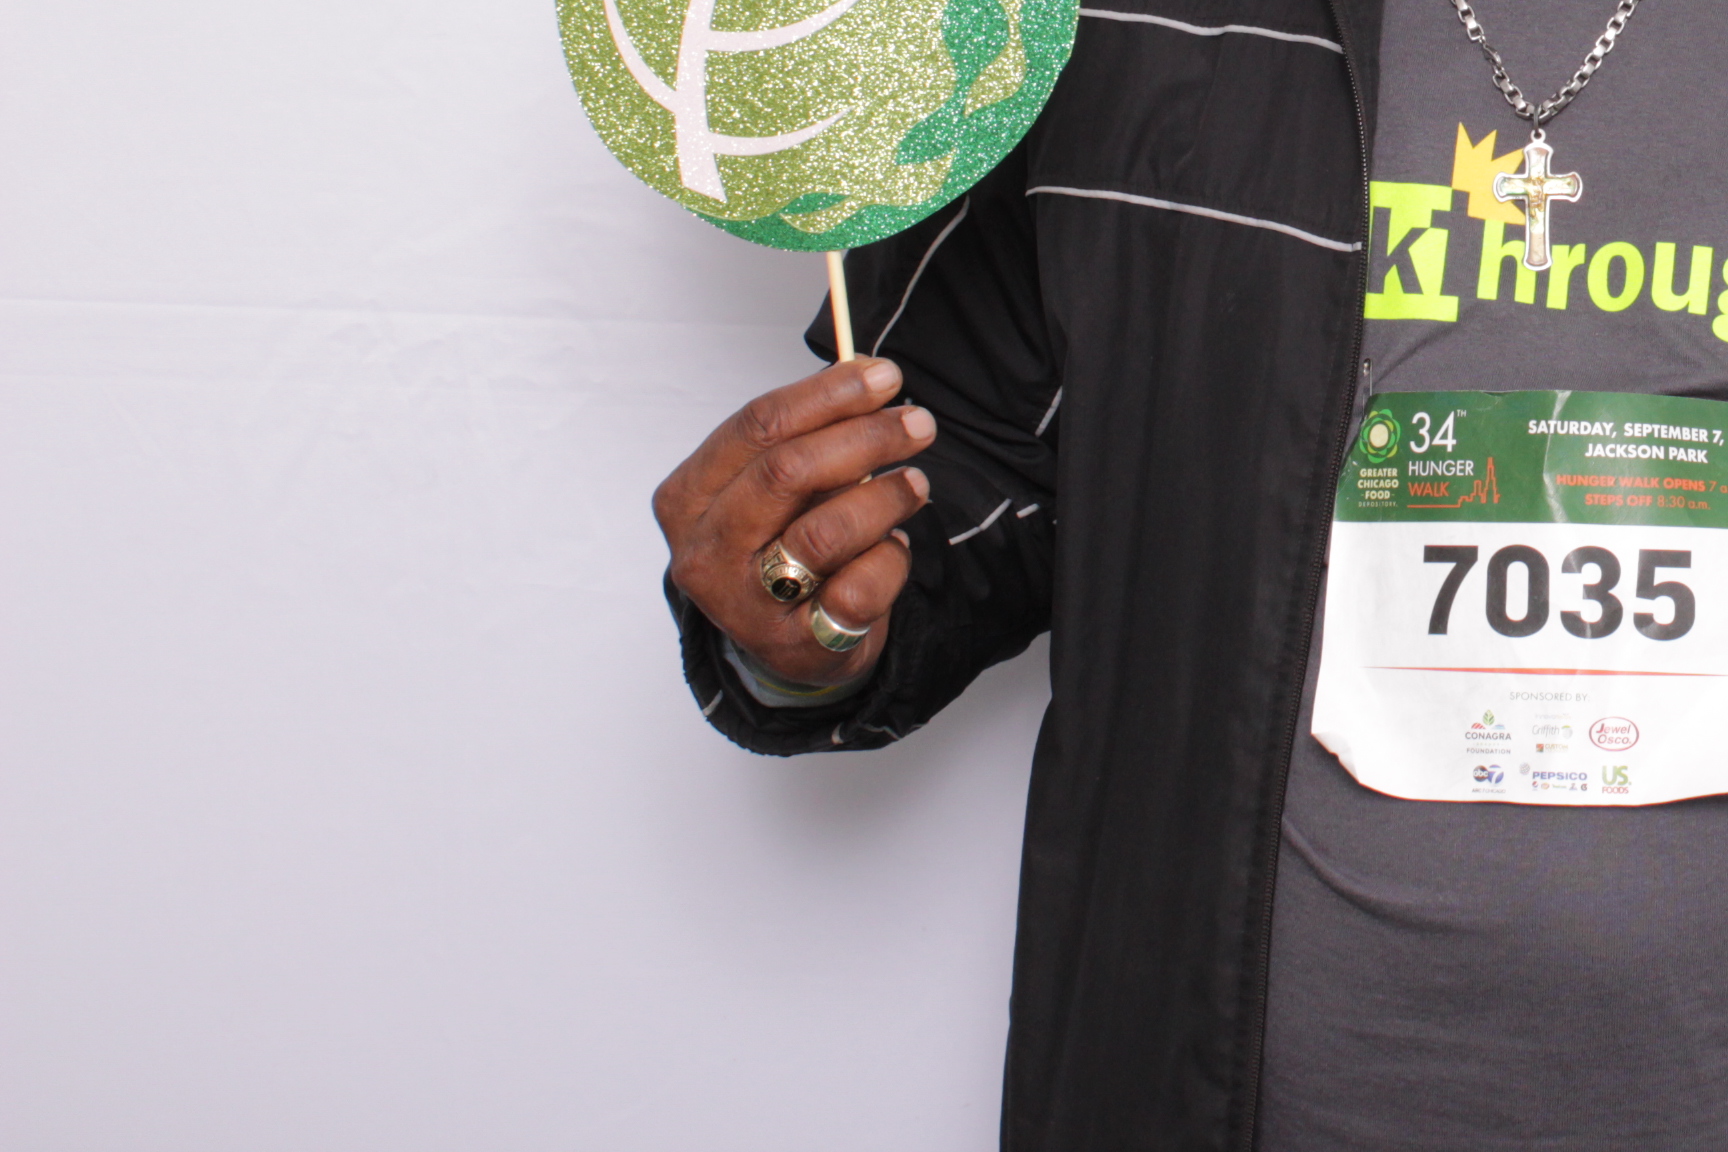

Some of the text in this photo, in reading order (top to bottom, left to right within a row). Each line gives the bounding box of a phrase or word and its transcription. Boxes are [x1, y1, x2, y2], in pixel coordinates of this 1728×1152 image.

[1528, 419, 1617, 439] SATURDAY,
[1623, 423, 1709, 443] SEPTEMBER
[1712, 430, 1724, 446] 7,
[1584, 443, 1708, 464] JACKSON PARK
[1359, 468, 1398, 478] GREATER
[1408, 460, 1474, 476] HUNGER
[1357, 479, 1399, 489] CHICAGO
[1556, 474, 1616, 488] HUNGER
[1618, 476, 1660, 489] WALK
[1663, 477, 1706, 492] OPENS
[1709, 481, 1717, 492] 7
[1407, 482, 1450, 497] WALK
[1584, 493, 1711, 510] STEPS OFF 8:30 a.m.
[1423, 544, 1697, 642] 7035
[1509, 691, 1573, 702] SPONSORED
[1532, 724, 1560, 738] Griffith
[1596, 723, 1631, 734] Jewel
[1465, 731, 1512, 740] CONAGRA
[1473, 768, 1489, 778] abc
[1532, 771, 1588, 781] PEPSICO
[1602, 786, 1629, 794] FOODS
